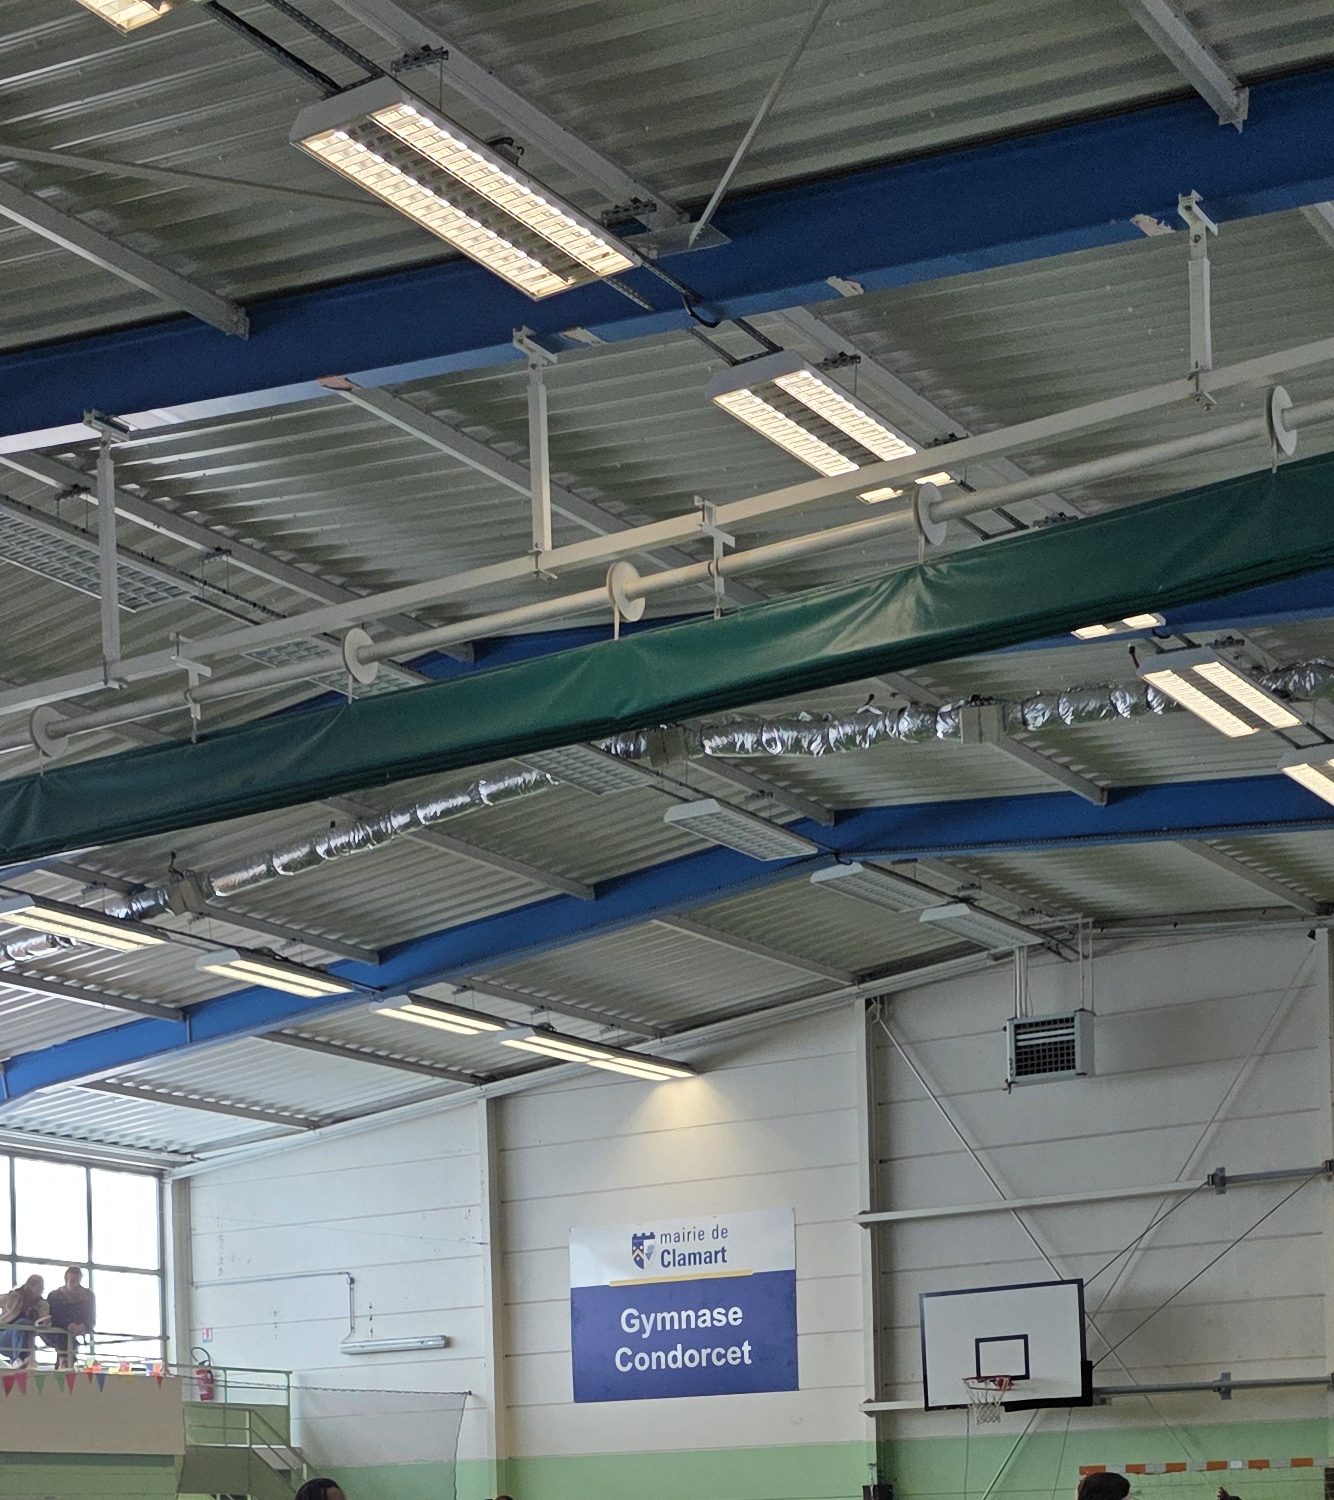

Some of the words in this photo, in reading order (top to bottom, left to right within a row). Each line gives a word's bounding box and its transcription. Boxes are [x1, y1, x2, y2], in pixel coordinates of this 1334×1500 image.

[660, 1226, 705, 1244] mairie
[712, 1224, 729, 1239] de
[660, 1246, 727, 1268] Clamart
[620, 1306, 743, 1338] Gymnase
[615, 1340, 752, 1372] Condorcet
